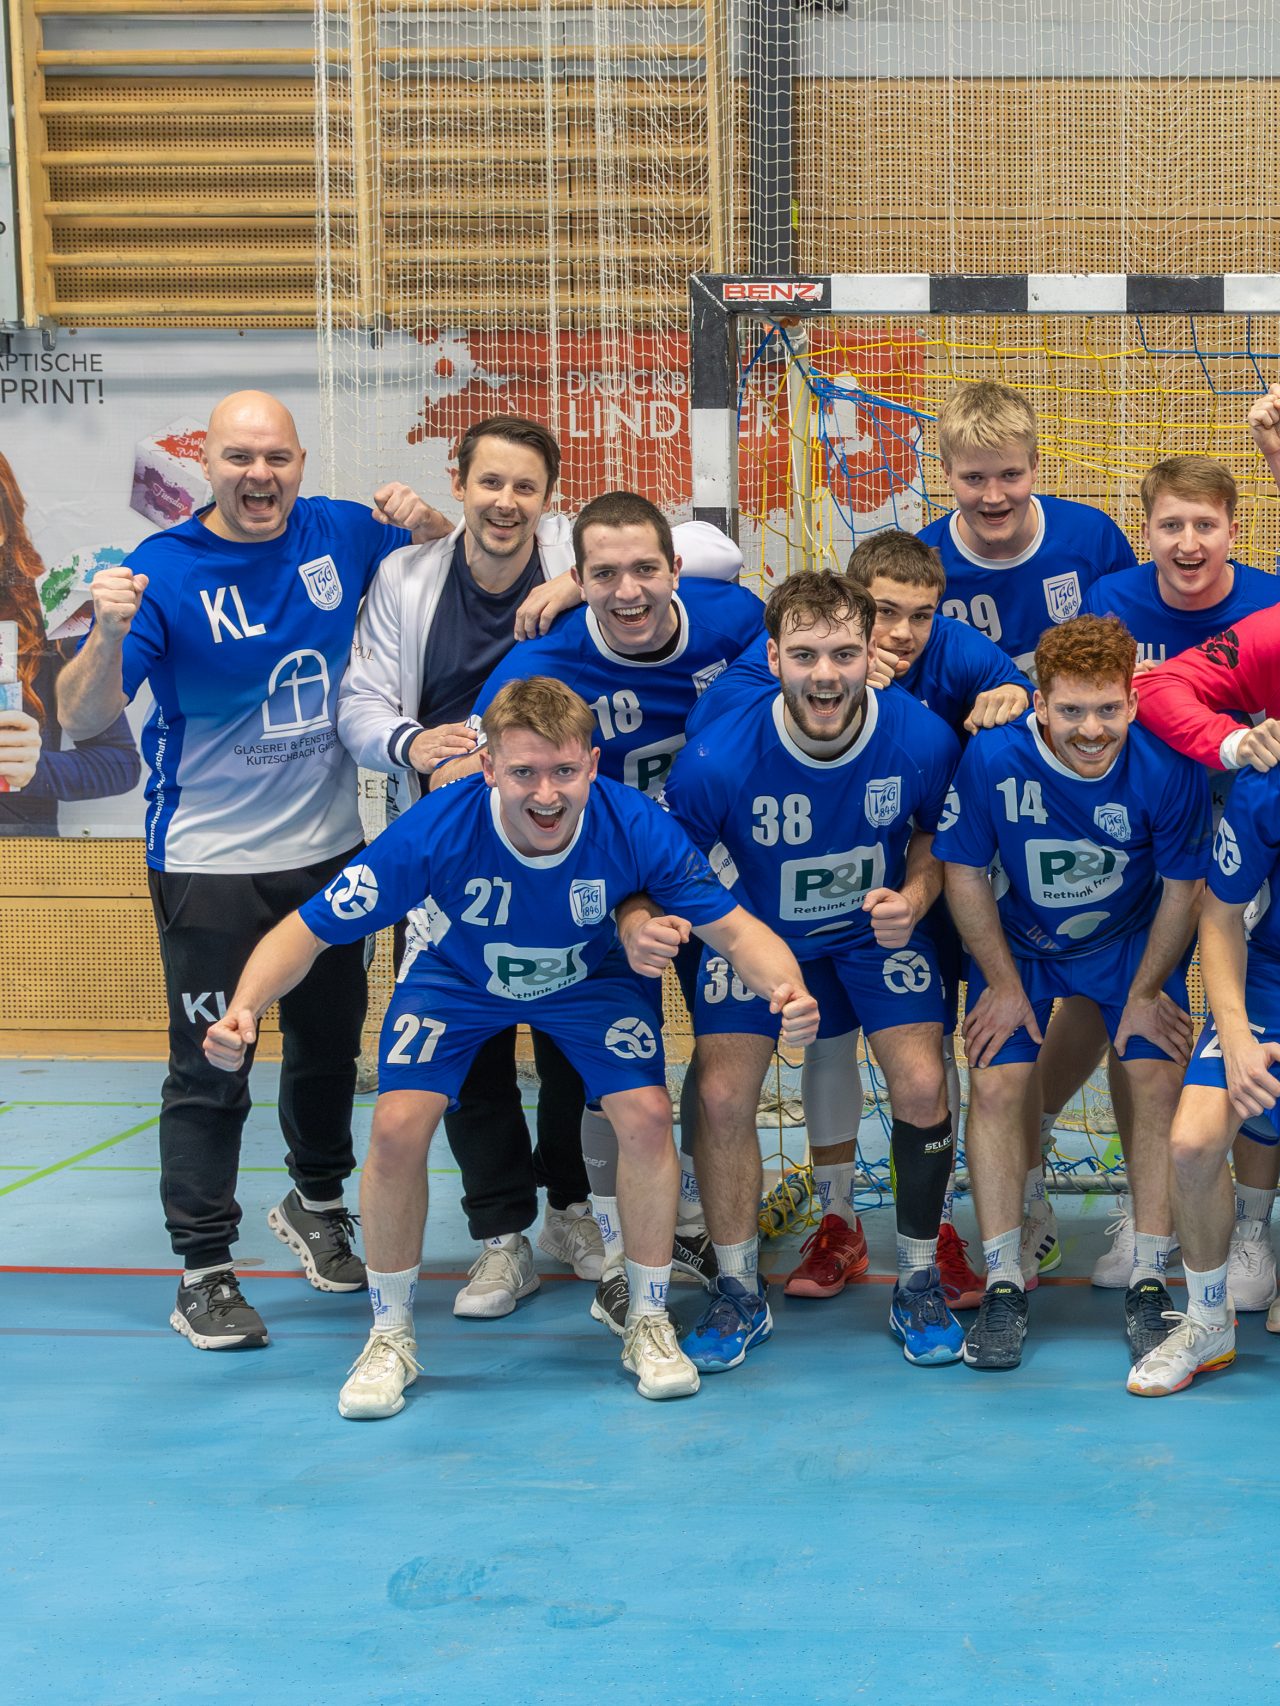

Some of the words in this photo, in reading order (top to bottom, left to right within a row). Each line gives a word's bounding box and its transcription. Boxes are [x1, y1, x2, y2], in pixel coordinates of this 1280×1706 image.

[724, 284, 816, 300] BENZ
[0, 354, 103, 372] PTISCHE
[1, 379, 103, 404] PRINT!
[567, 371, 779, 395] DRUCKBEB
[570, 401, 778, 437] LINDER
[308, 563, 334, 596] TSG
[1050, 581, 1076, 610] TSG
[1062, 599, 1078, 616] 1846
[199, 585, 267, 643] KL
[589, 689, 643, 741] 18
[234, 742, 287, 755] GLASEREI
[290, 741, 298, 750] &
[246, 748, 316, 766] KUTZSCHBACH
[870, 785, 896, 815] TSG
[996, 777, 1049, 825] 14
[752, 793, 813, 847] 38
[794, 858, 874, 902] P&I
[1039, 849, 1117, 886] P&I
[461, 877, 512, 926] 27
[574, 886, 599, 913] TSG
[1043, 884, 1093, 900] Rethink
[582, 905, 600, 918] 1846
[794, 900, 846, 914] Rethink
[498, 948, 577, 986] P&I
[386, 1014, 447, 1065] 27
[925, 1132, 953, 1151] SELEC
